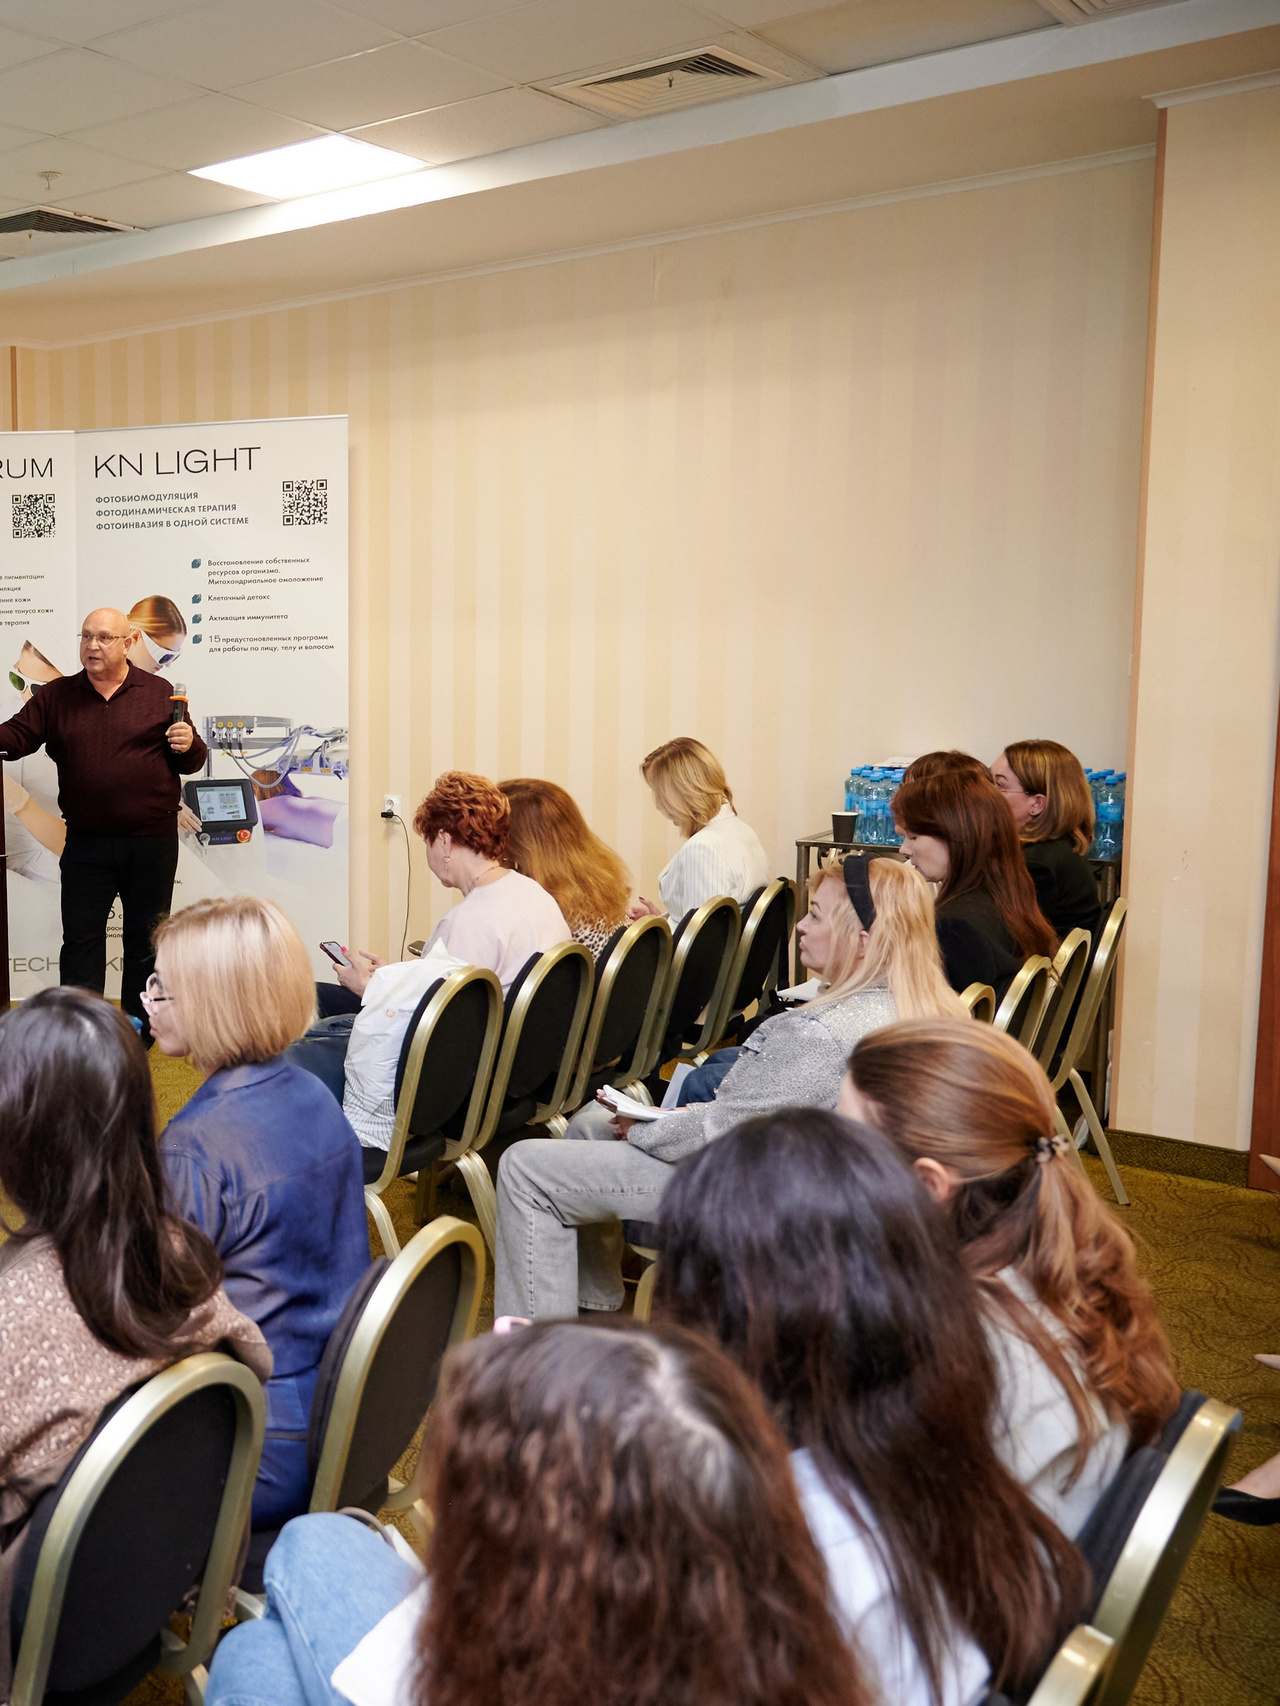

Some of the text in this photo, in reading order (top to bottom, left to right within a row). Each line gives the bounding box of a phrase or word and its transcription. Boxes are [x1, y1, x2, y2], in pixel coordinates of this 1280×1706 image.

[94, 446, 261, 479] KN LIGHT
[95, 491, 199, 504] ФОТОБИОМОДУЛЯЦИЯ
[95, 504, 237, 517] ФОТОДИНАМИЧЕСКАЯ ТЕРАПИЯ
[95, 516, 249, 531] ФОТОИНВАЗИЯ В ОДНОЙ СИСТЕМЕ
[207, 557, 310, 567] Восстановление собственных
[207, 568, 281, 577] ресурсов организма.
[208, 576, 324, 586] Митохондриальное омоложение
[208, 594, 270, 602] Клеточный детокс
[208, 614, 246, 622] Активация
[208, 634, 328, 644] 15 предустановленных программ
[208, 646, 221, 654] для
[222, 644, 248, 654] работы
[260, 645, 279, 653] лицу,
